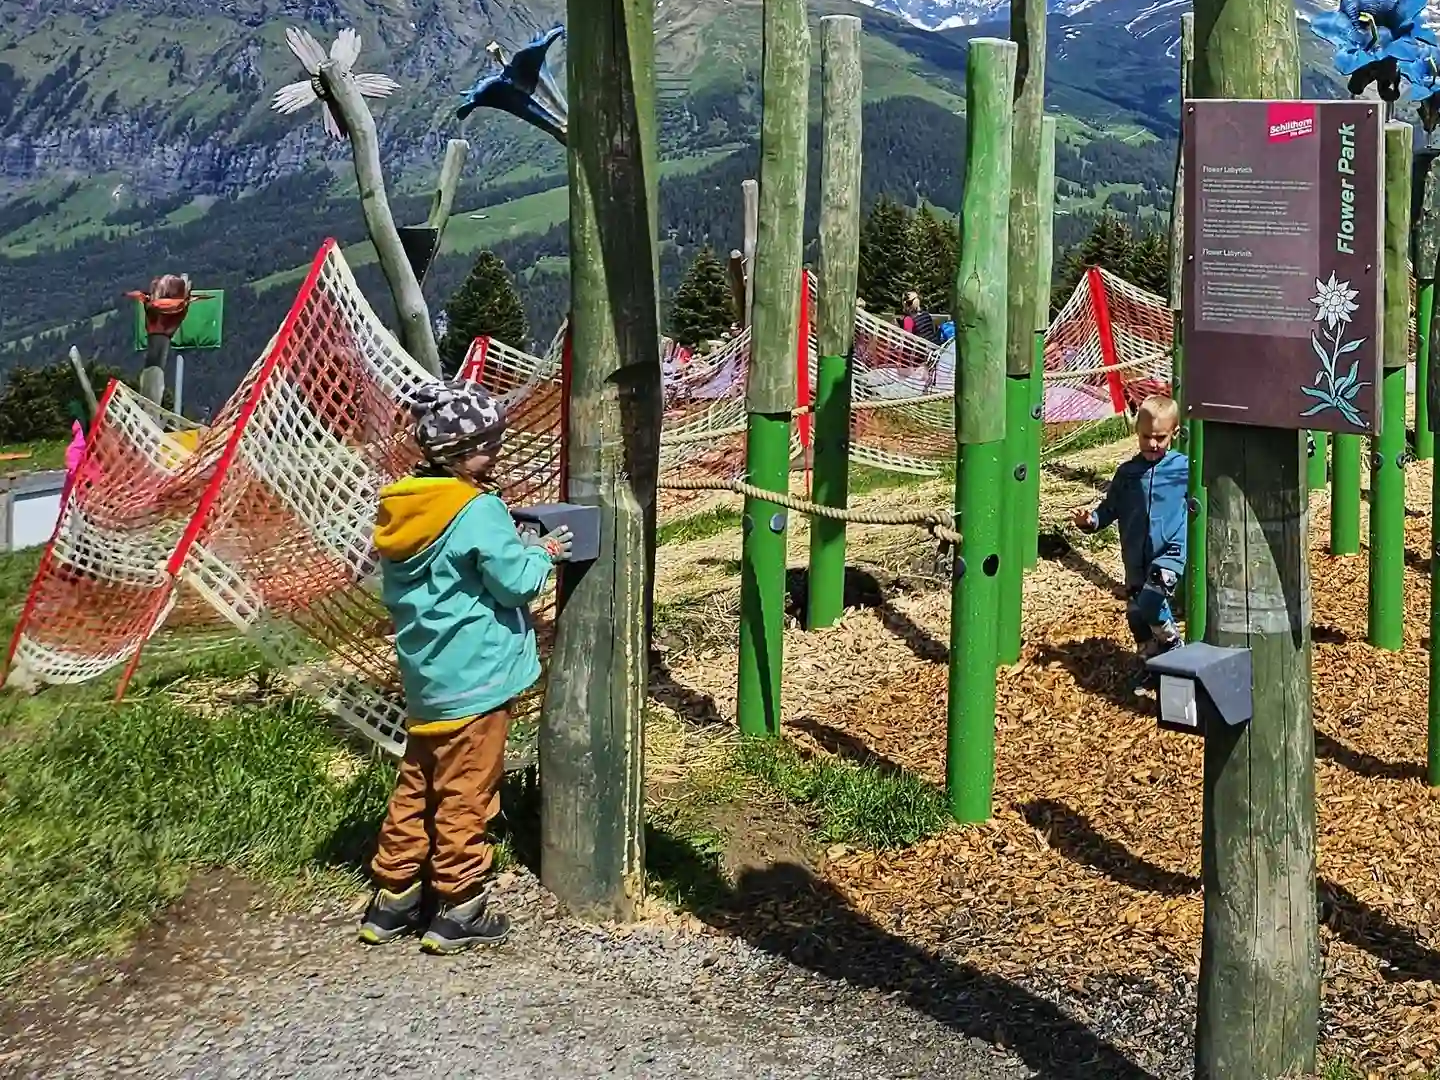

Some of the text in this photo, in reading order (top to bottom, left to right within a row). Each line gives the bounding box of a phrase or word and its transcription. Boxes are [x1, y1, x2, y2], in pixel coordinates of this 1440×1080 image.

[1269, 118, 1313, 134] Schilthorn
[1337, 121, 1356, 255] Flower Park
